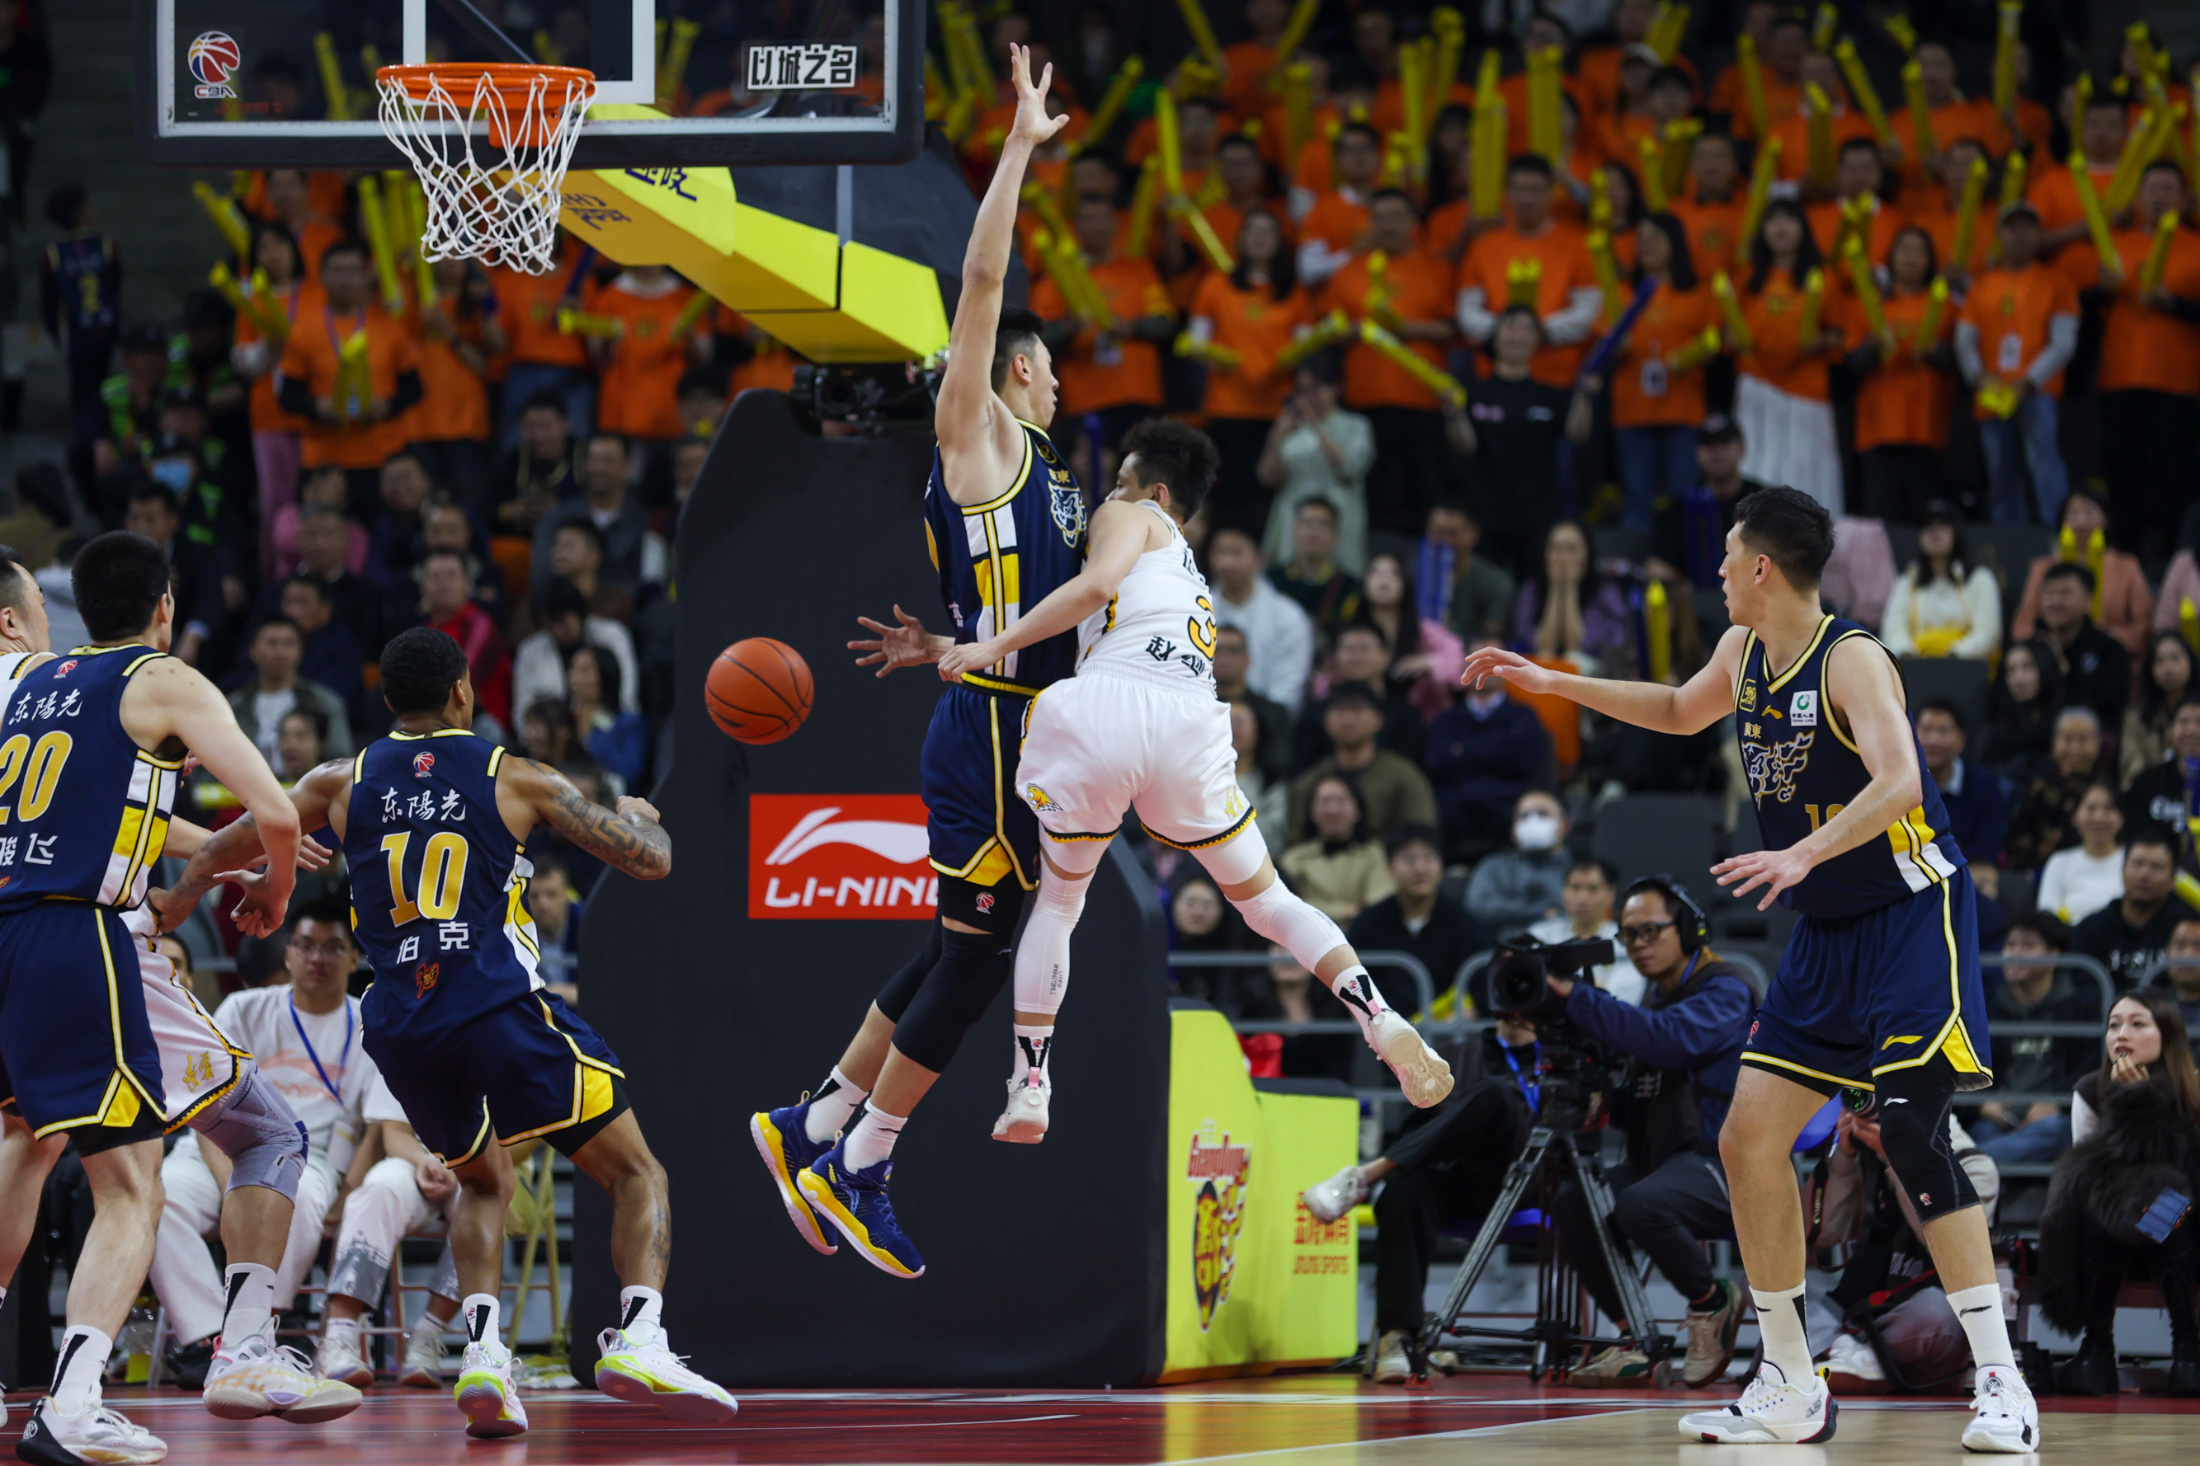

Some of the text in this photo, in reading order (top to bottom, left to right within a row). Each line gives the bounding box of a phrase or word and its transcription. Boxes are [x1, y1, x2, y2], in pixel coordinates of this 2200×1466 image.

[195, 85, 238, 98] CBA
[749, 46, 856, 88] 以城之名
[1188, 595, 1217, 662] 3
[0, 731, 73, 825] 20
[380, 831, 469, 928] 10
[396, 921, 470, 965] 伯克
